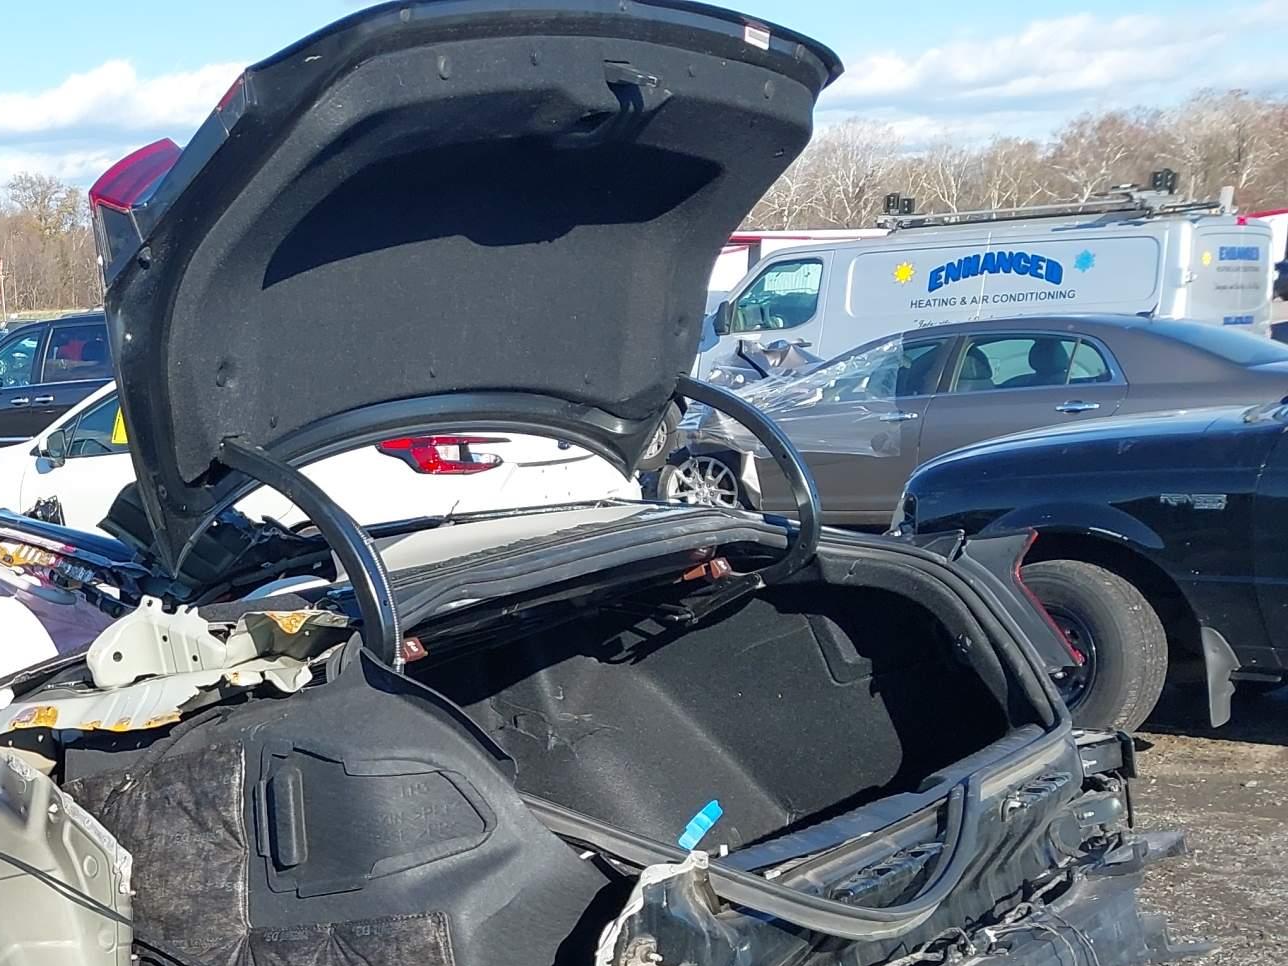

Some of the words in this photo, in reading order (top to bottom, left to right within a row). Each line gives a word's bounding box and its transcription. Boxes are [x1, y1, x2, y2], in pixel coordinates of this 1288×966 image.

[927, 251, 1064, 293] ENHANCED
[910, 297, 957, 309] HEATING
[961, 296, 968, 306] &
[970, 293, 990, 305] AIR
[992, 289, 1077, 304] CONDITIONING
